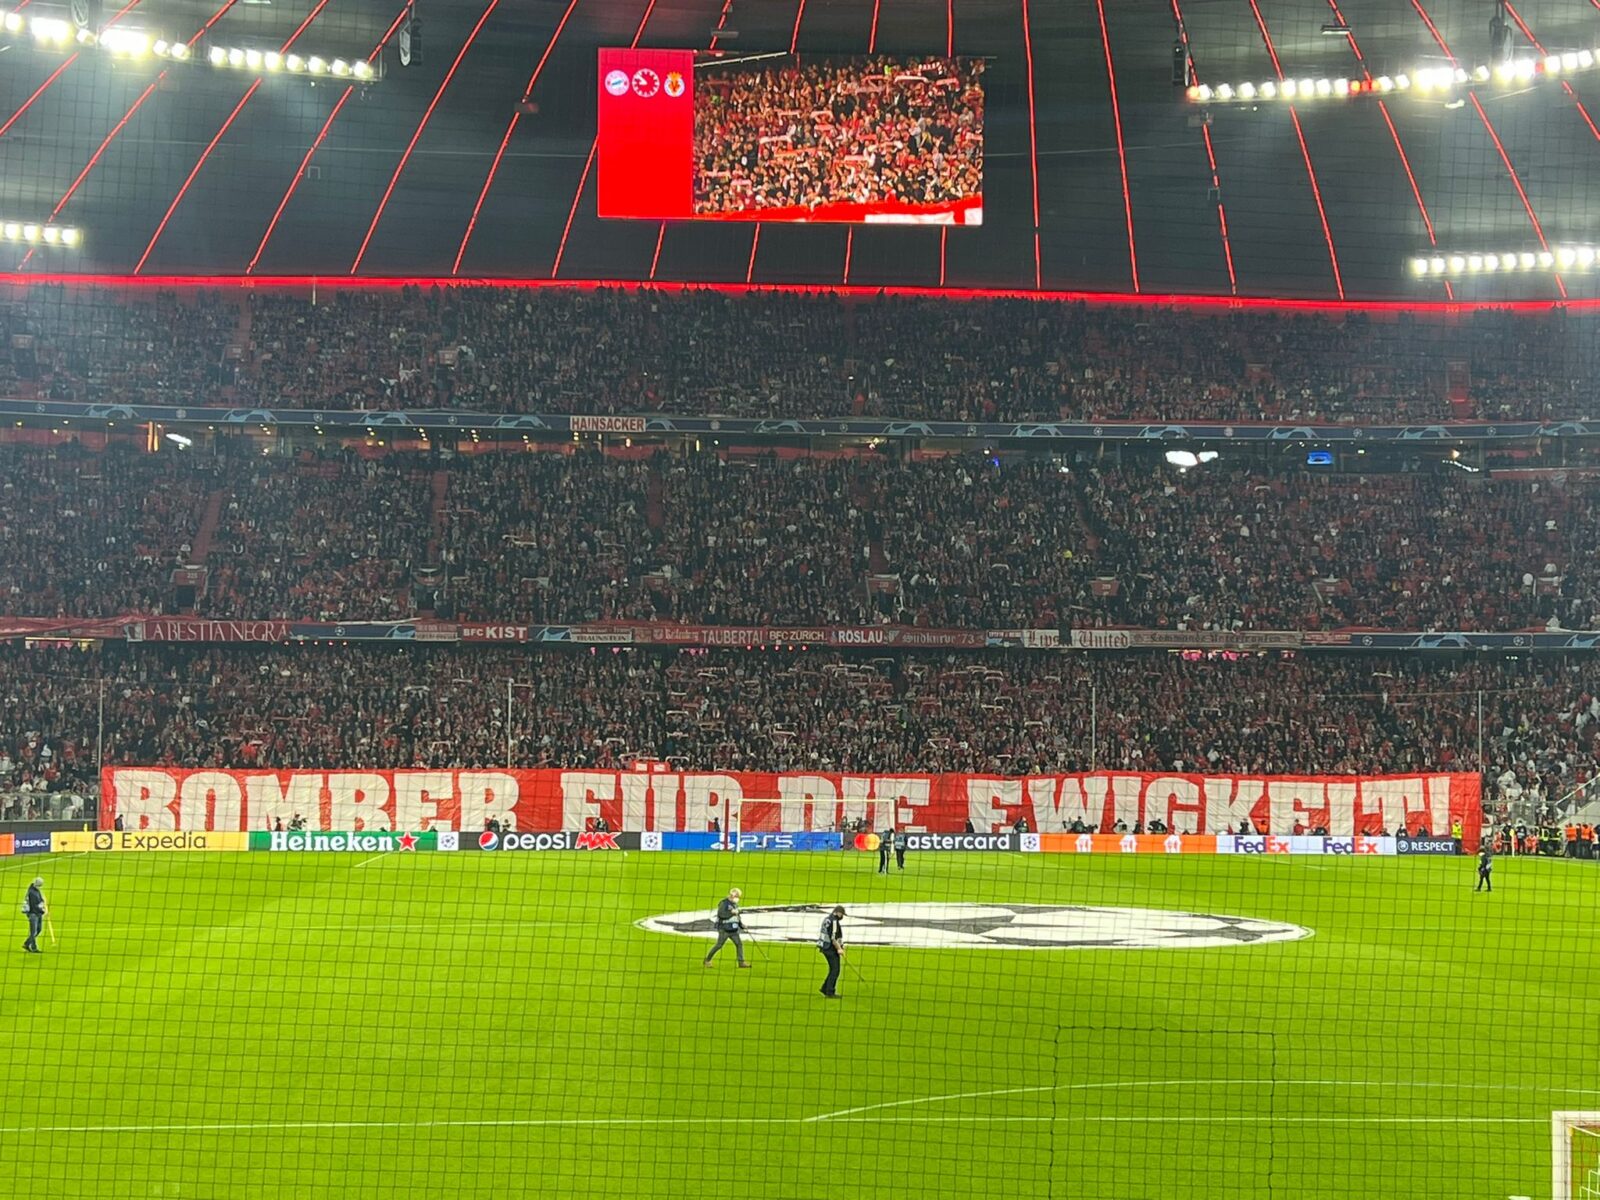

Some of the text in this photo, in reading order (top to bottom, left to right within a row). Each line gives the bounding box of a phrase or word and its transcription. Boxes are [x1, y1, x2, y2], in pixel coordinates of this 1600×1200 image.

[571, 417, 645, 431] HAINSACKER
[143, 621, 288, 642] LA BESTIA NEGRA
[463, 628, 484, 637] BFC
[485, 626, 527, 639] KIST
[769, 630, 788, 640] BFC
[1078, 630, 1129, 648] United
[112, 762, 1452, 836] BOMBER FÜR DIE EWIGKEIT!
[21, 838, 50, 848] RESPECT
[121, 832, 207, 851] Expedia
[270, 831, 394, 851] Heineken
[503, 832, 622, 850] pepsi MAX
[740, 835, 794, 848] PS5
[906, 834, 1010, 850] astercard
[1234, 836, 1292, 854] FedEx
[1323, 836, 1379, 854] FedEx
[1411, 841, 1454, 851] RESPECT
